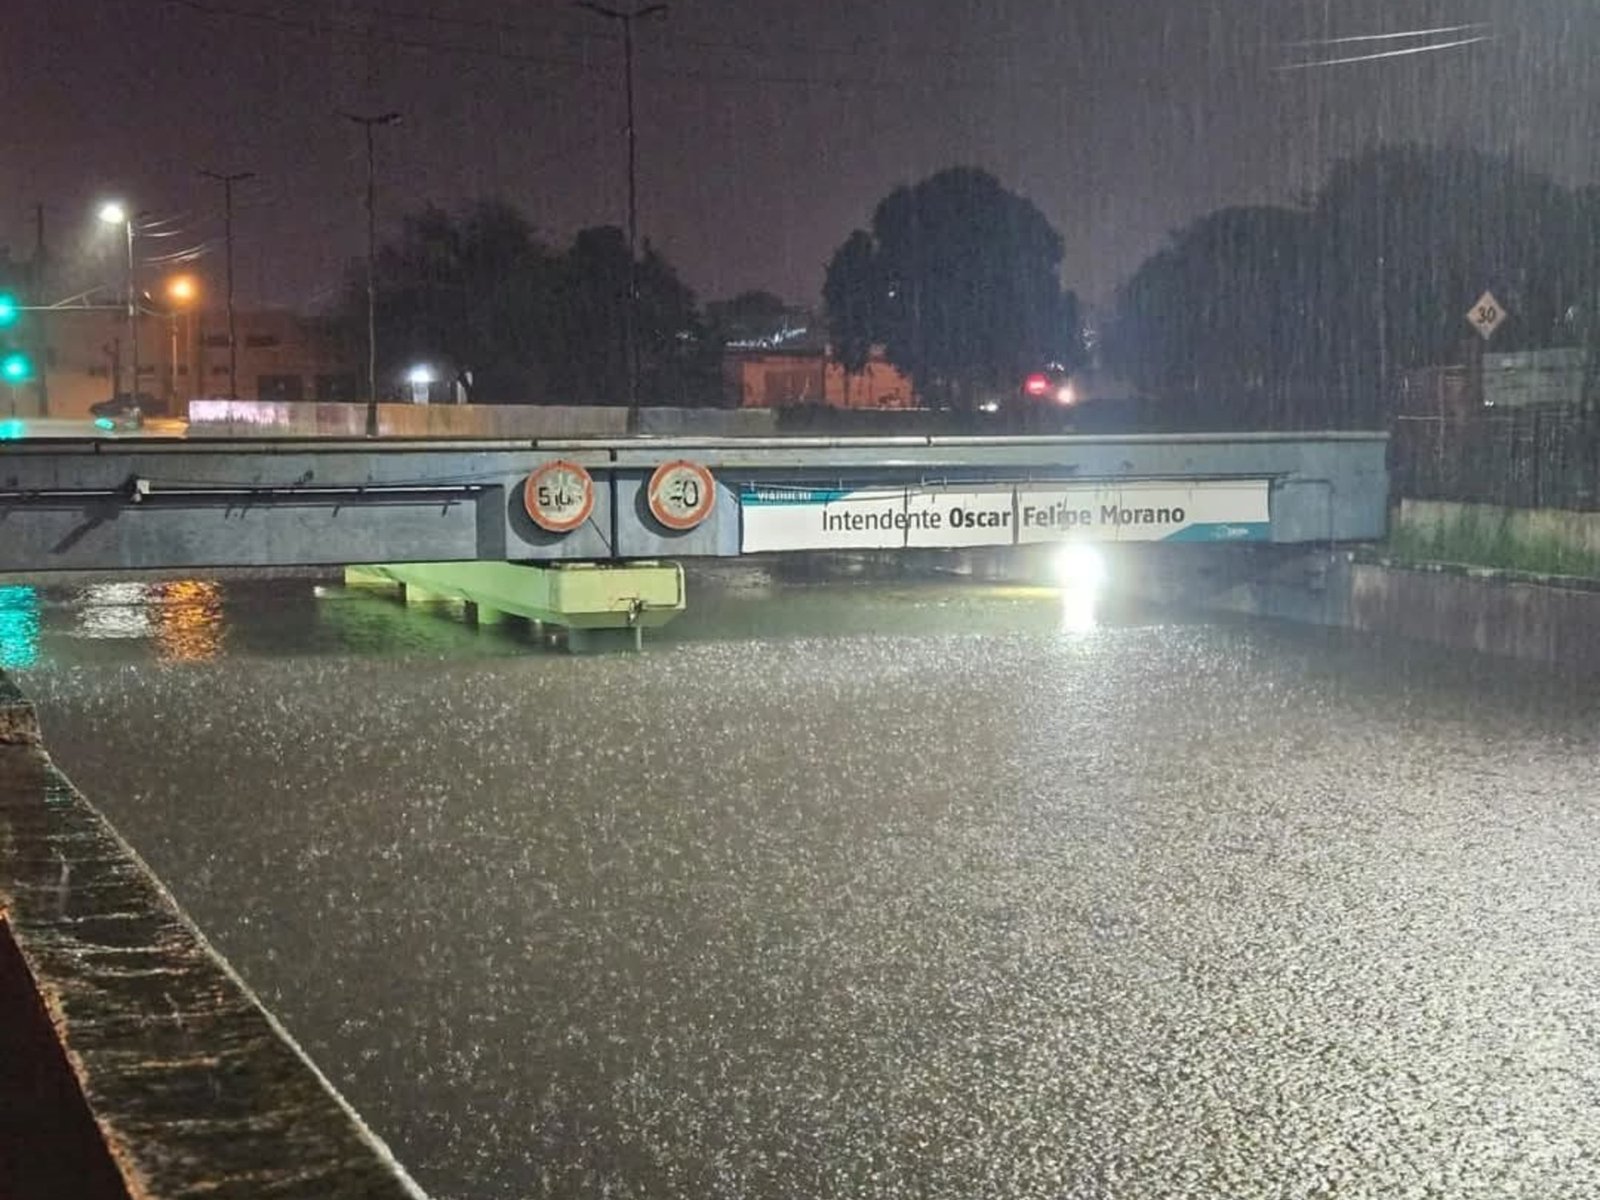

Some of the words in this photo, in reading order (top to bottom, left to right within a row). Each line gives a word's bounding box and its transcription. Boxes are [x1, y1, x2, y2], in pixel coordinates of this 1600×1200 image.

[1477, 305, 1496, 324] 30
[822, 509, 942, 531] Intendente
[949, 507, 1012, 528] Oscar
[1023, 502, 1091, 531] Felipe
[1100, 505, 1185, 525] Morano
